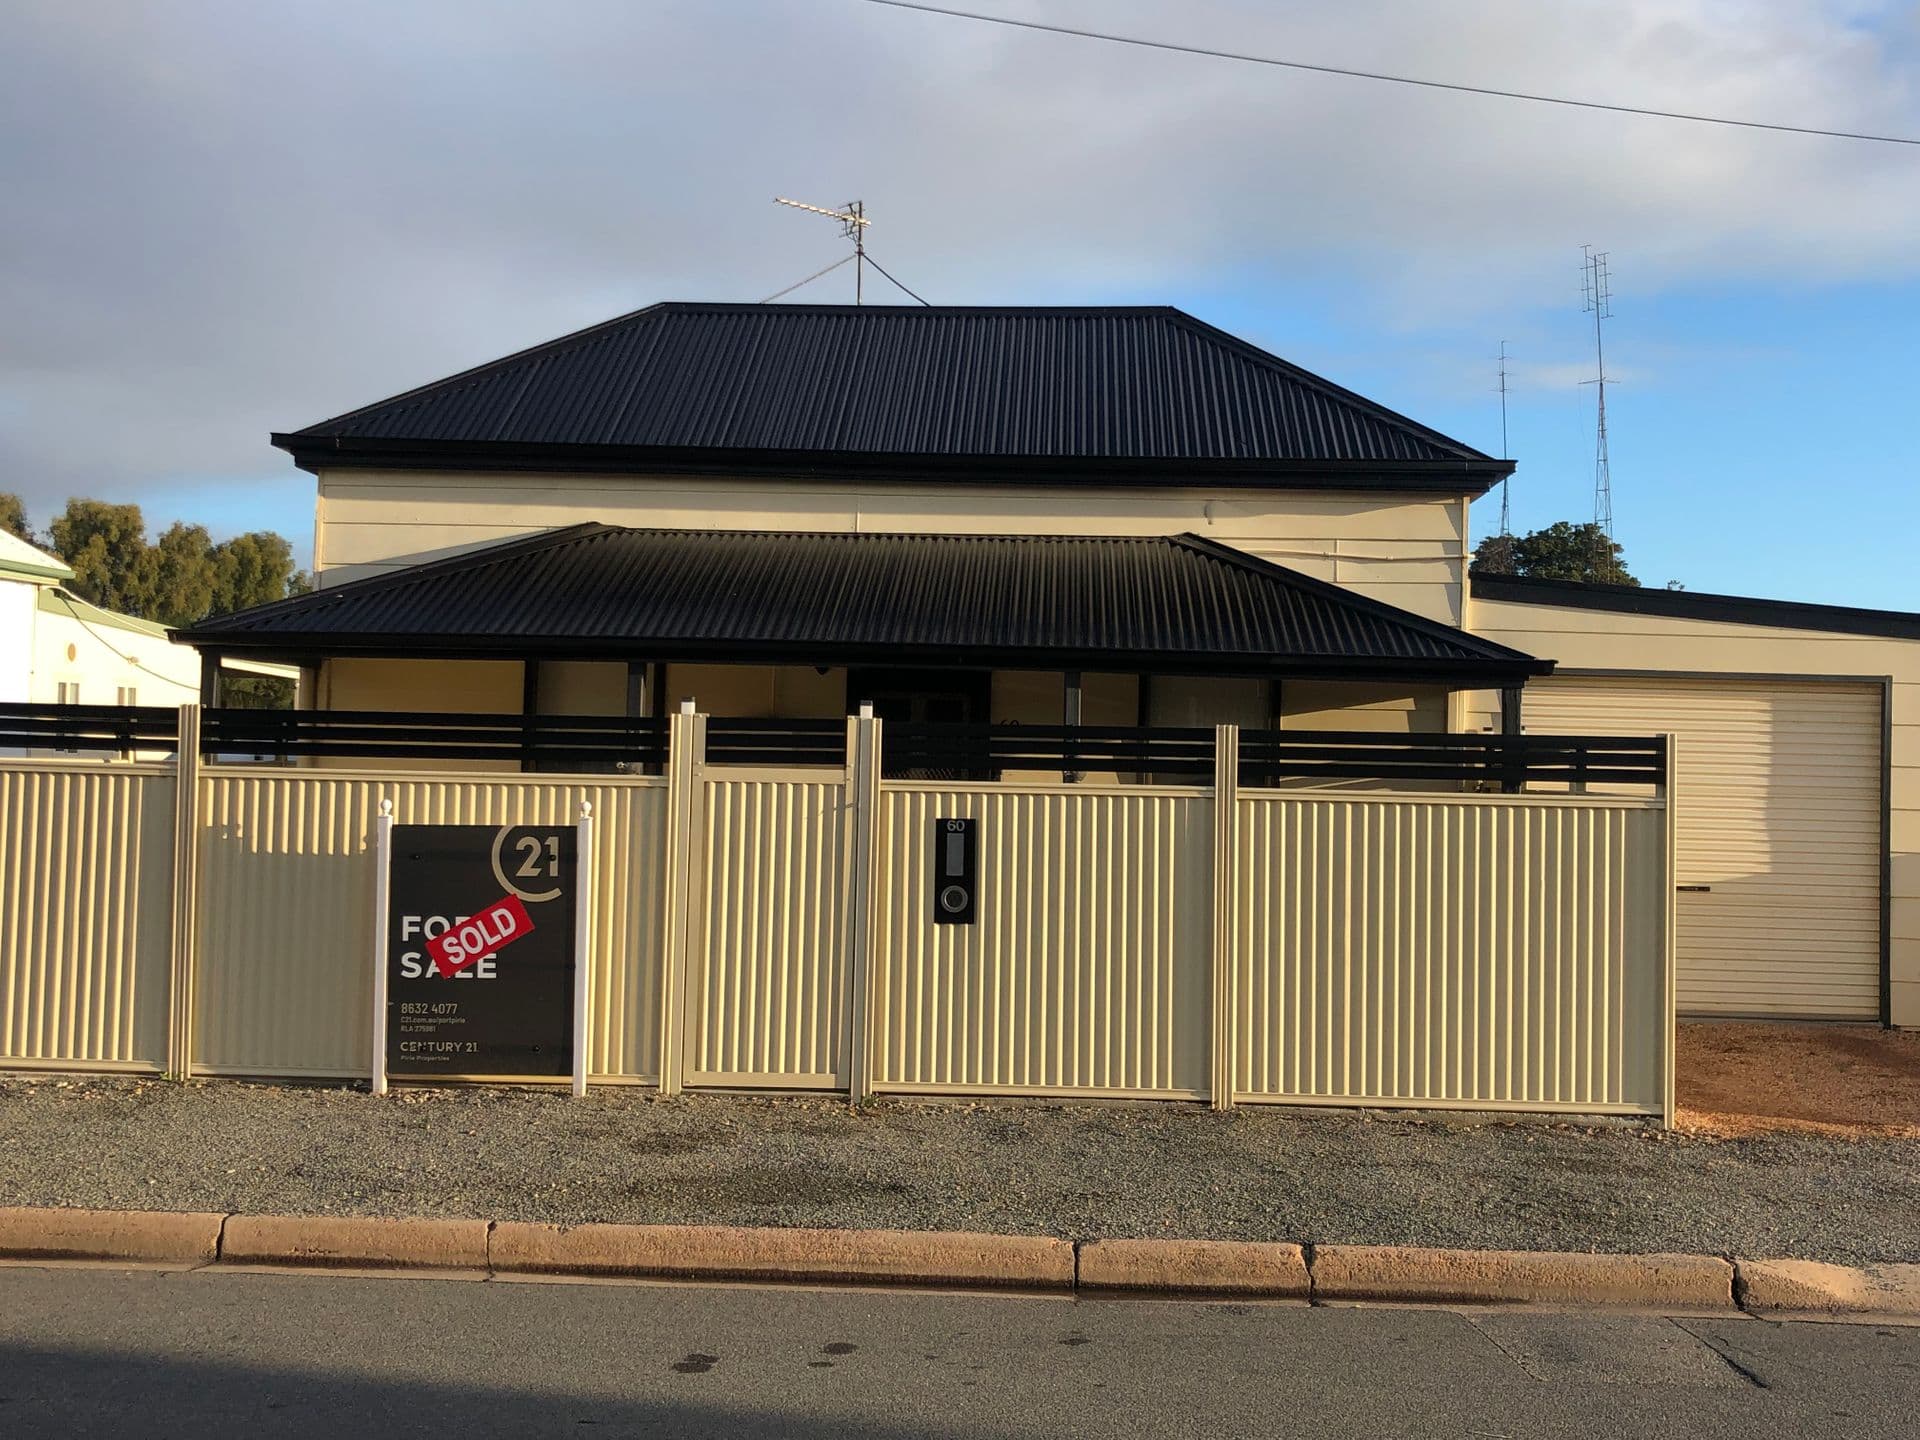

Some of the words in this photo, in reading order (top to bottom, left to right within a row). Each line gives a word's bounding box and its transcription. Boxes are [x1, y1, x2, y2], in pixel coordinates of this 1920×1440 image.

[946, 819, 965, 832] 60
[402, 915, 471, 942] FO
[442, 908, 516, 965] SOLD
[401, 1003, 428, 1014] 8632
[431, 1003, 458, 1015] 4077
[400, 1041, 463, 1053] CENTURY
[465, 1042, 478, 1053] 21
